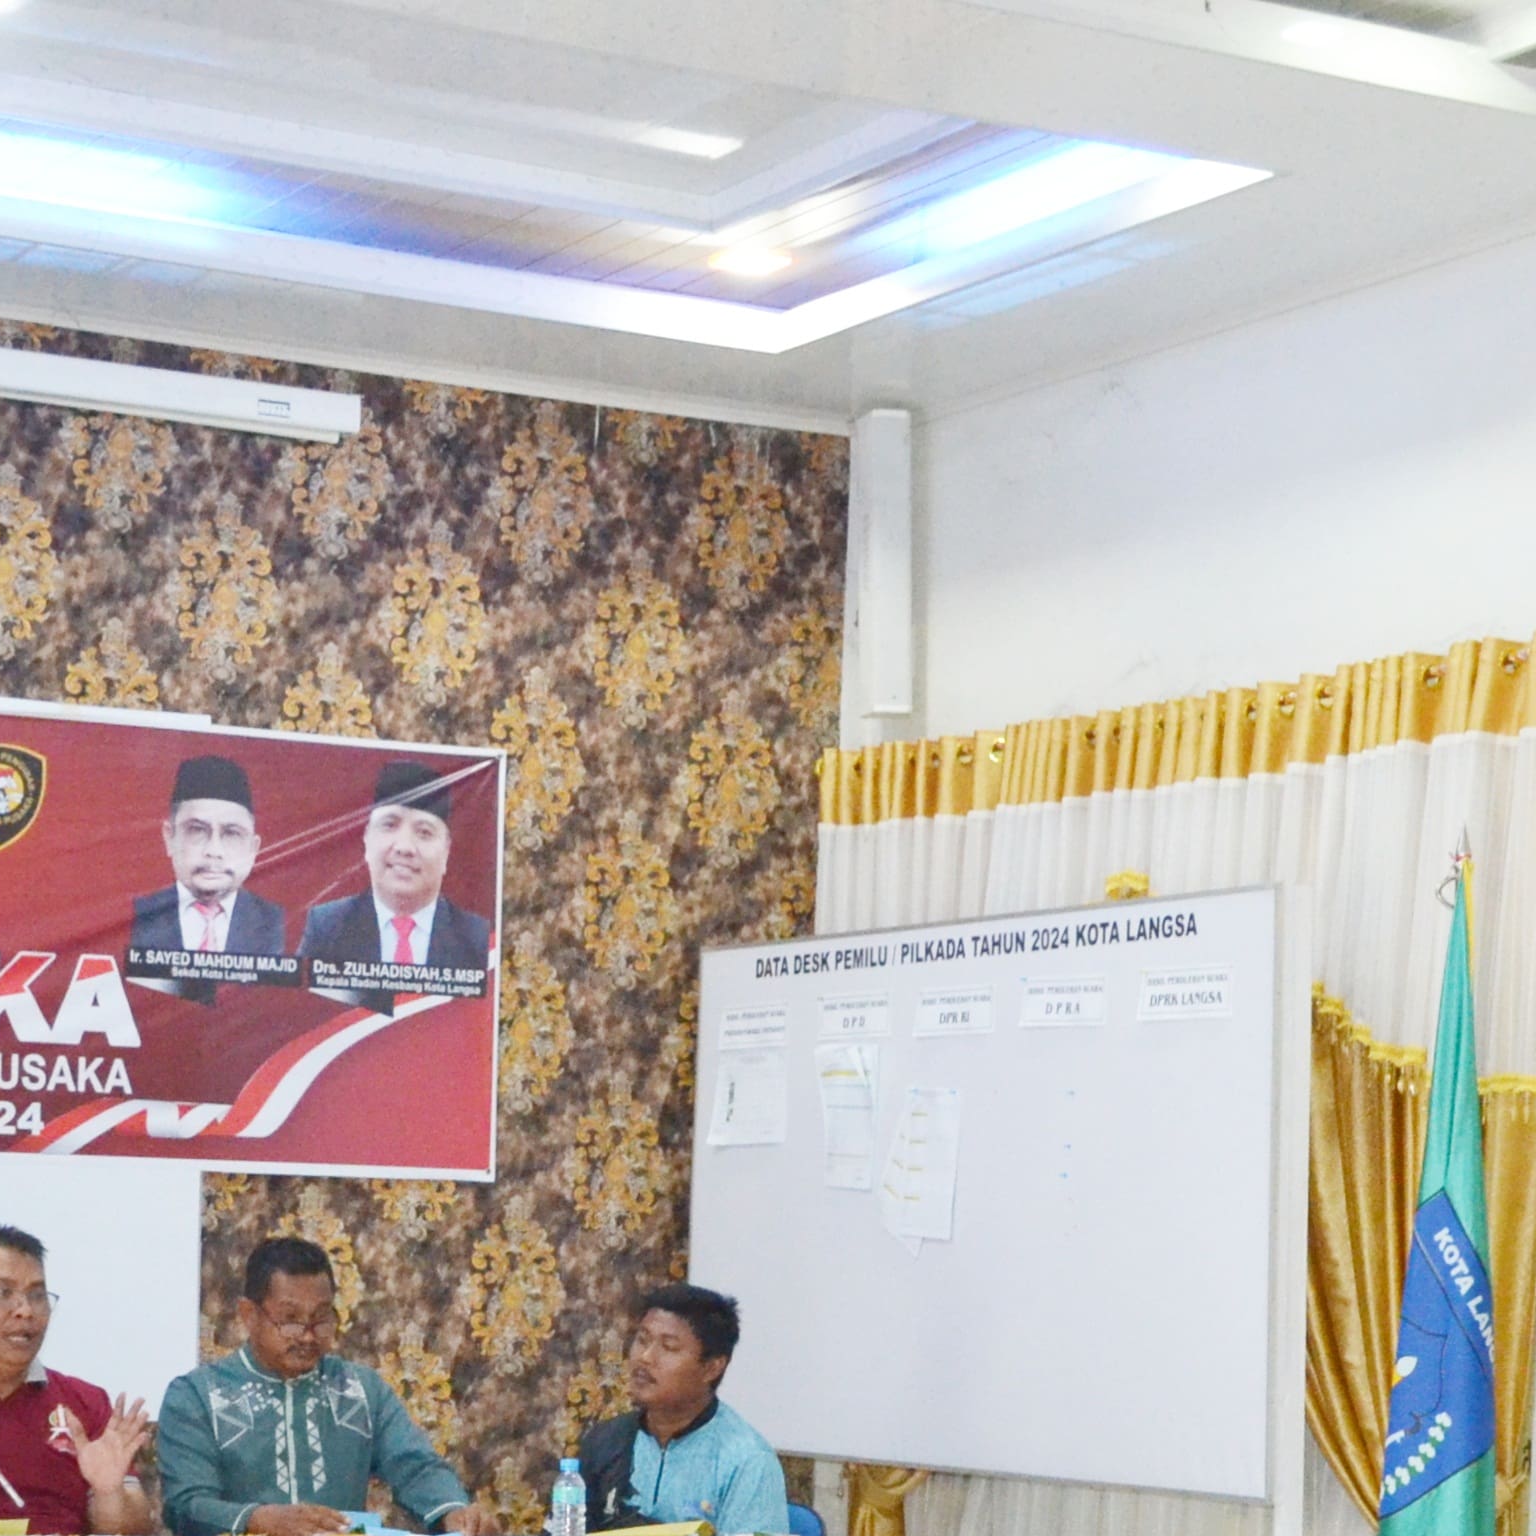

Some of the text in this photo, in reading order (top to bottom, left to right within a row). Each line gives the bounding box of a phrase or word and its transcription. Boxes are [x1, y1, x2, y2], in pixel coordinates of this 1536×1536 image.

[755, 955, 789, 979] DATA
[793, 951, 830, 975] DESK
[835, 945, 889, 971] PEMILU
[900, 936, 966, 965] PILKADA
[972, 930, 1025, 958] TAHUN
[1031, 925, 1070, 952] 2024
[1075, 920, 1120, 948] KOTA
[1126, 912, 1198, 942] LANGSA
[129, 949, 298, 973] Ir. SAYED MAHDUM MAJID
[313, 959, 340, 975] Drs.
[201, 968, 223, 980] Kota
[225, 969, 258, 982] Langsa
[424, 981, 446, 994] Kota
[1433, 1227, 1475, 1296] KOTA
